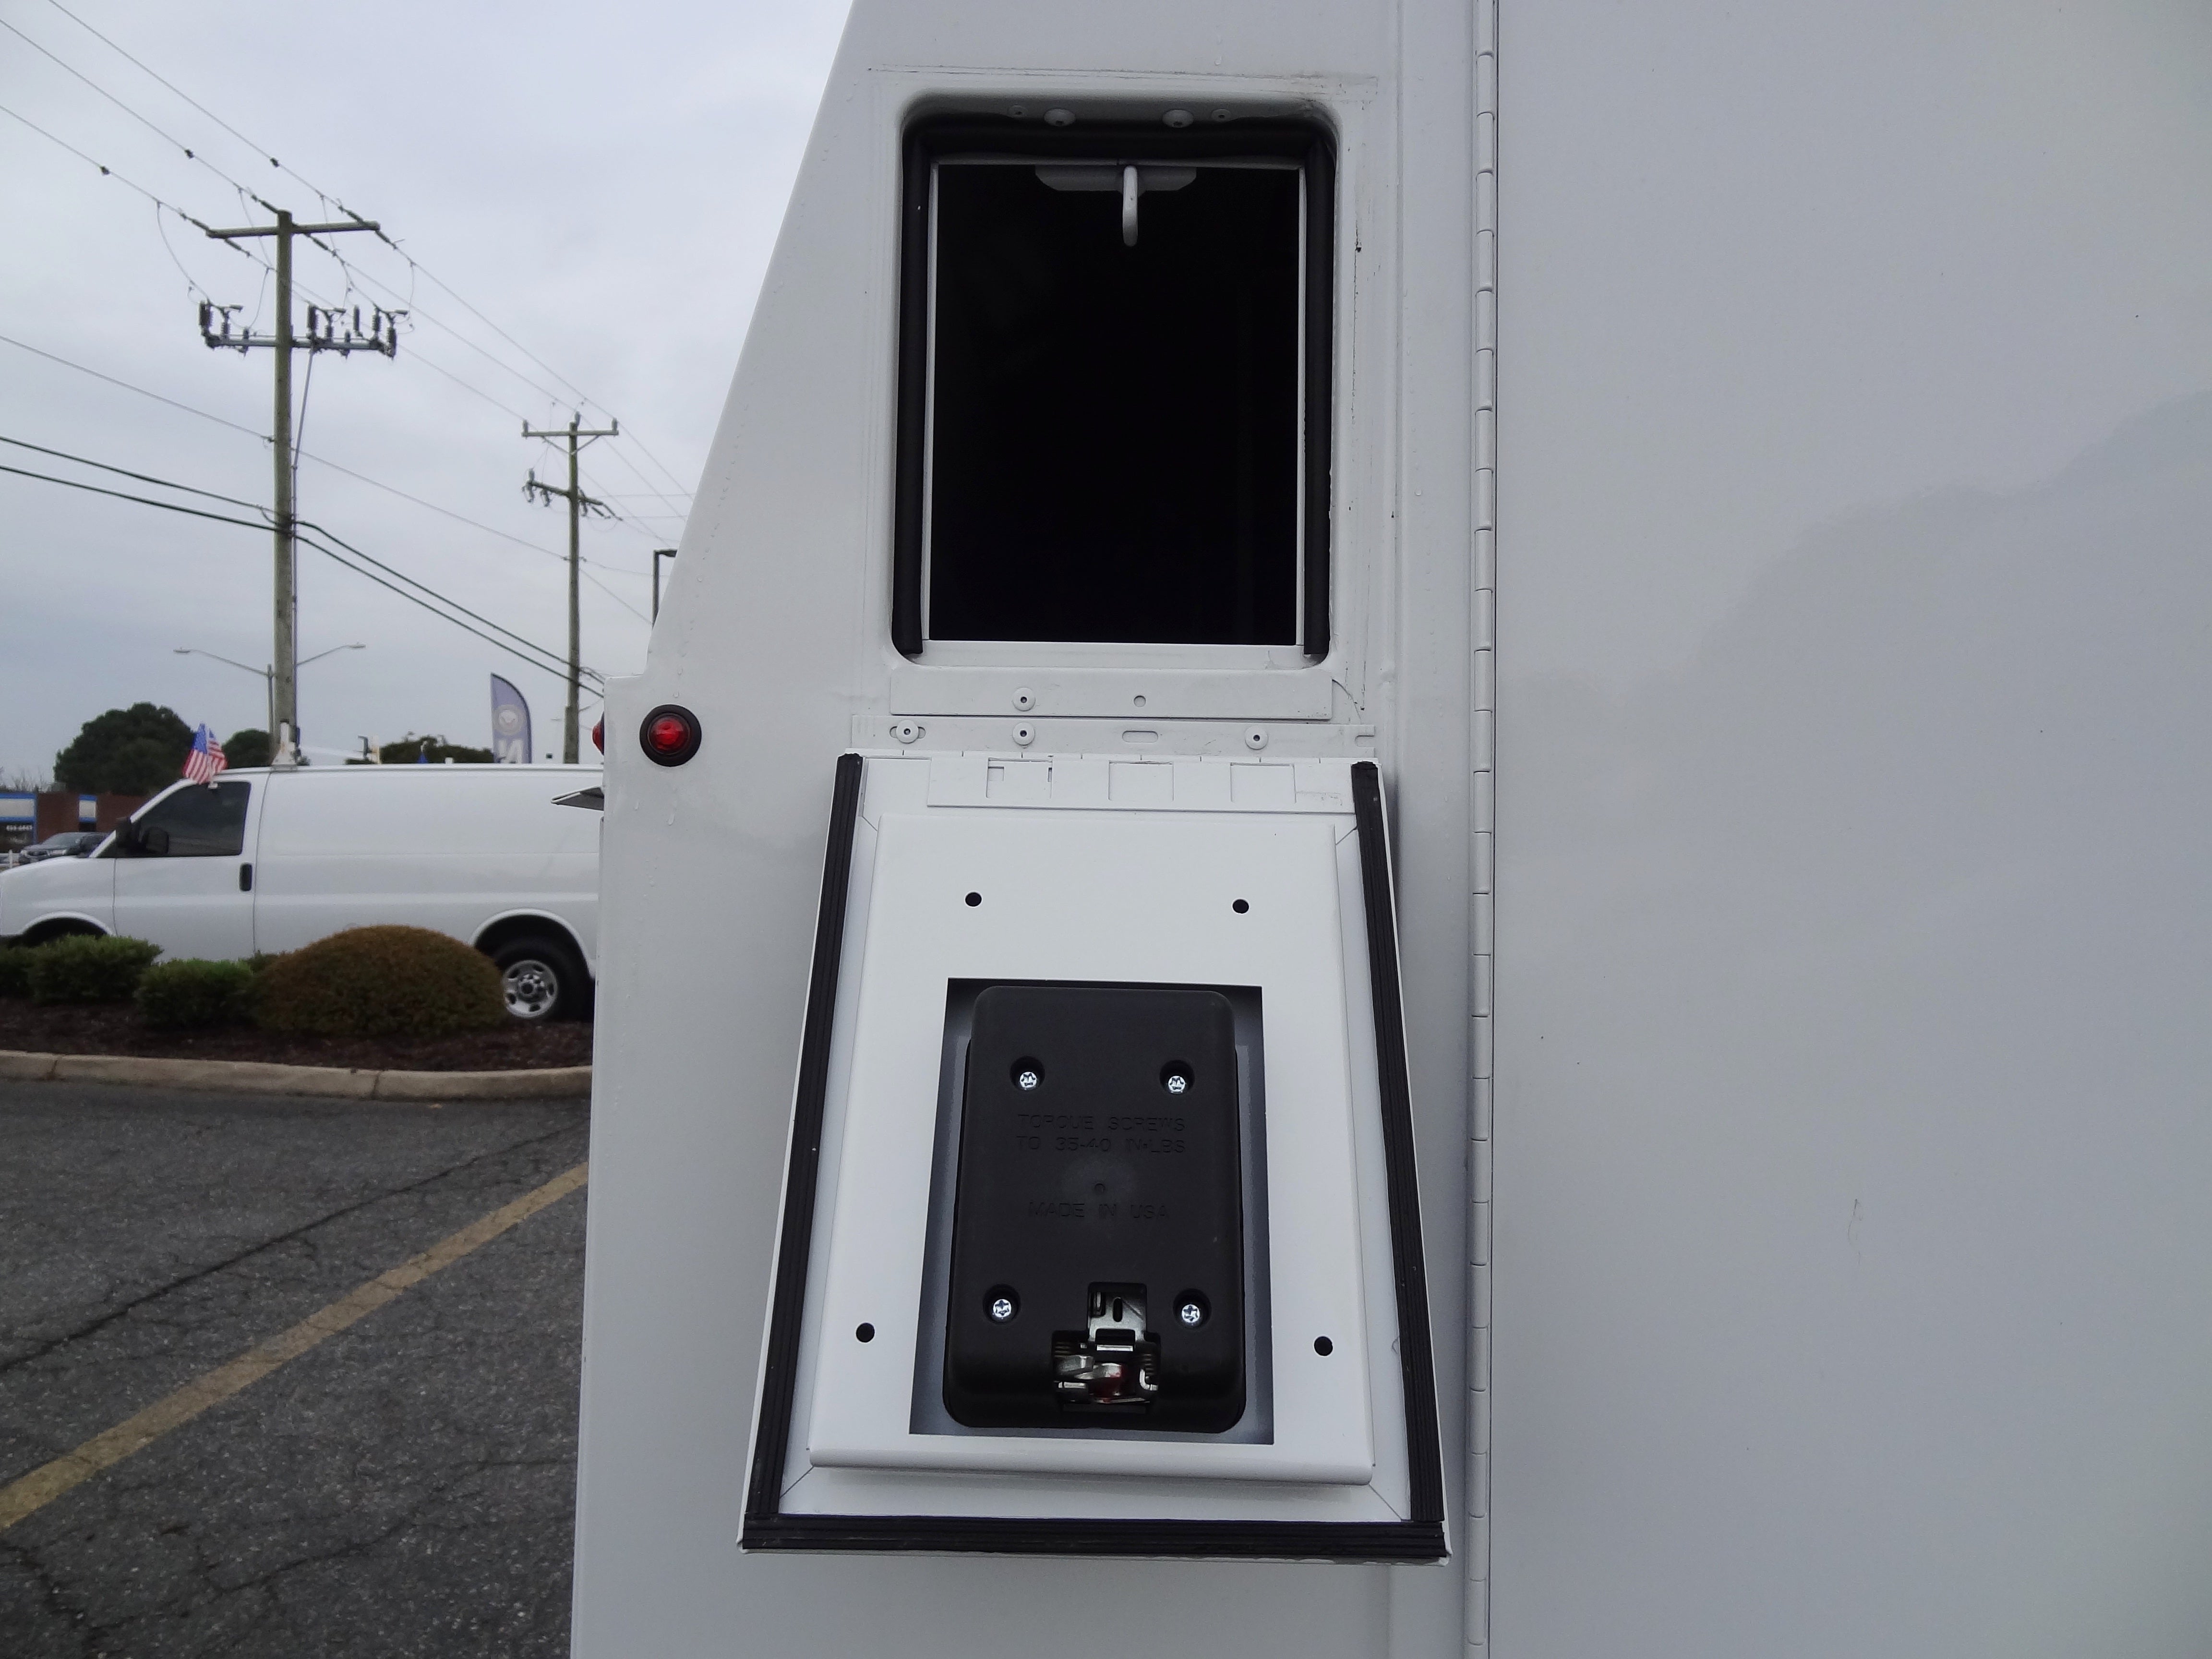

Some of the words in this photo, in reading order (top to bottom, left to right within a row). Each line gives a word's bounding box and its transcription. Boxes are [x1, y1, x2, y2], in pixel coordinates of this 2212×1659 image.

[1018, 1114, 1094, 1130] TORQUE
[1108, 1117, 1185, 1131] SCREWS
[1016, 1136, 1041, 1150] TO
[1056, 1137, 1111, 1152] 35-40
[1030, 1202, 1084, 1218] MADE
[1099, 1204, 1117, 1218] IN
[1130, 1204, 1168, 1219] USA
